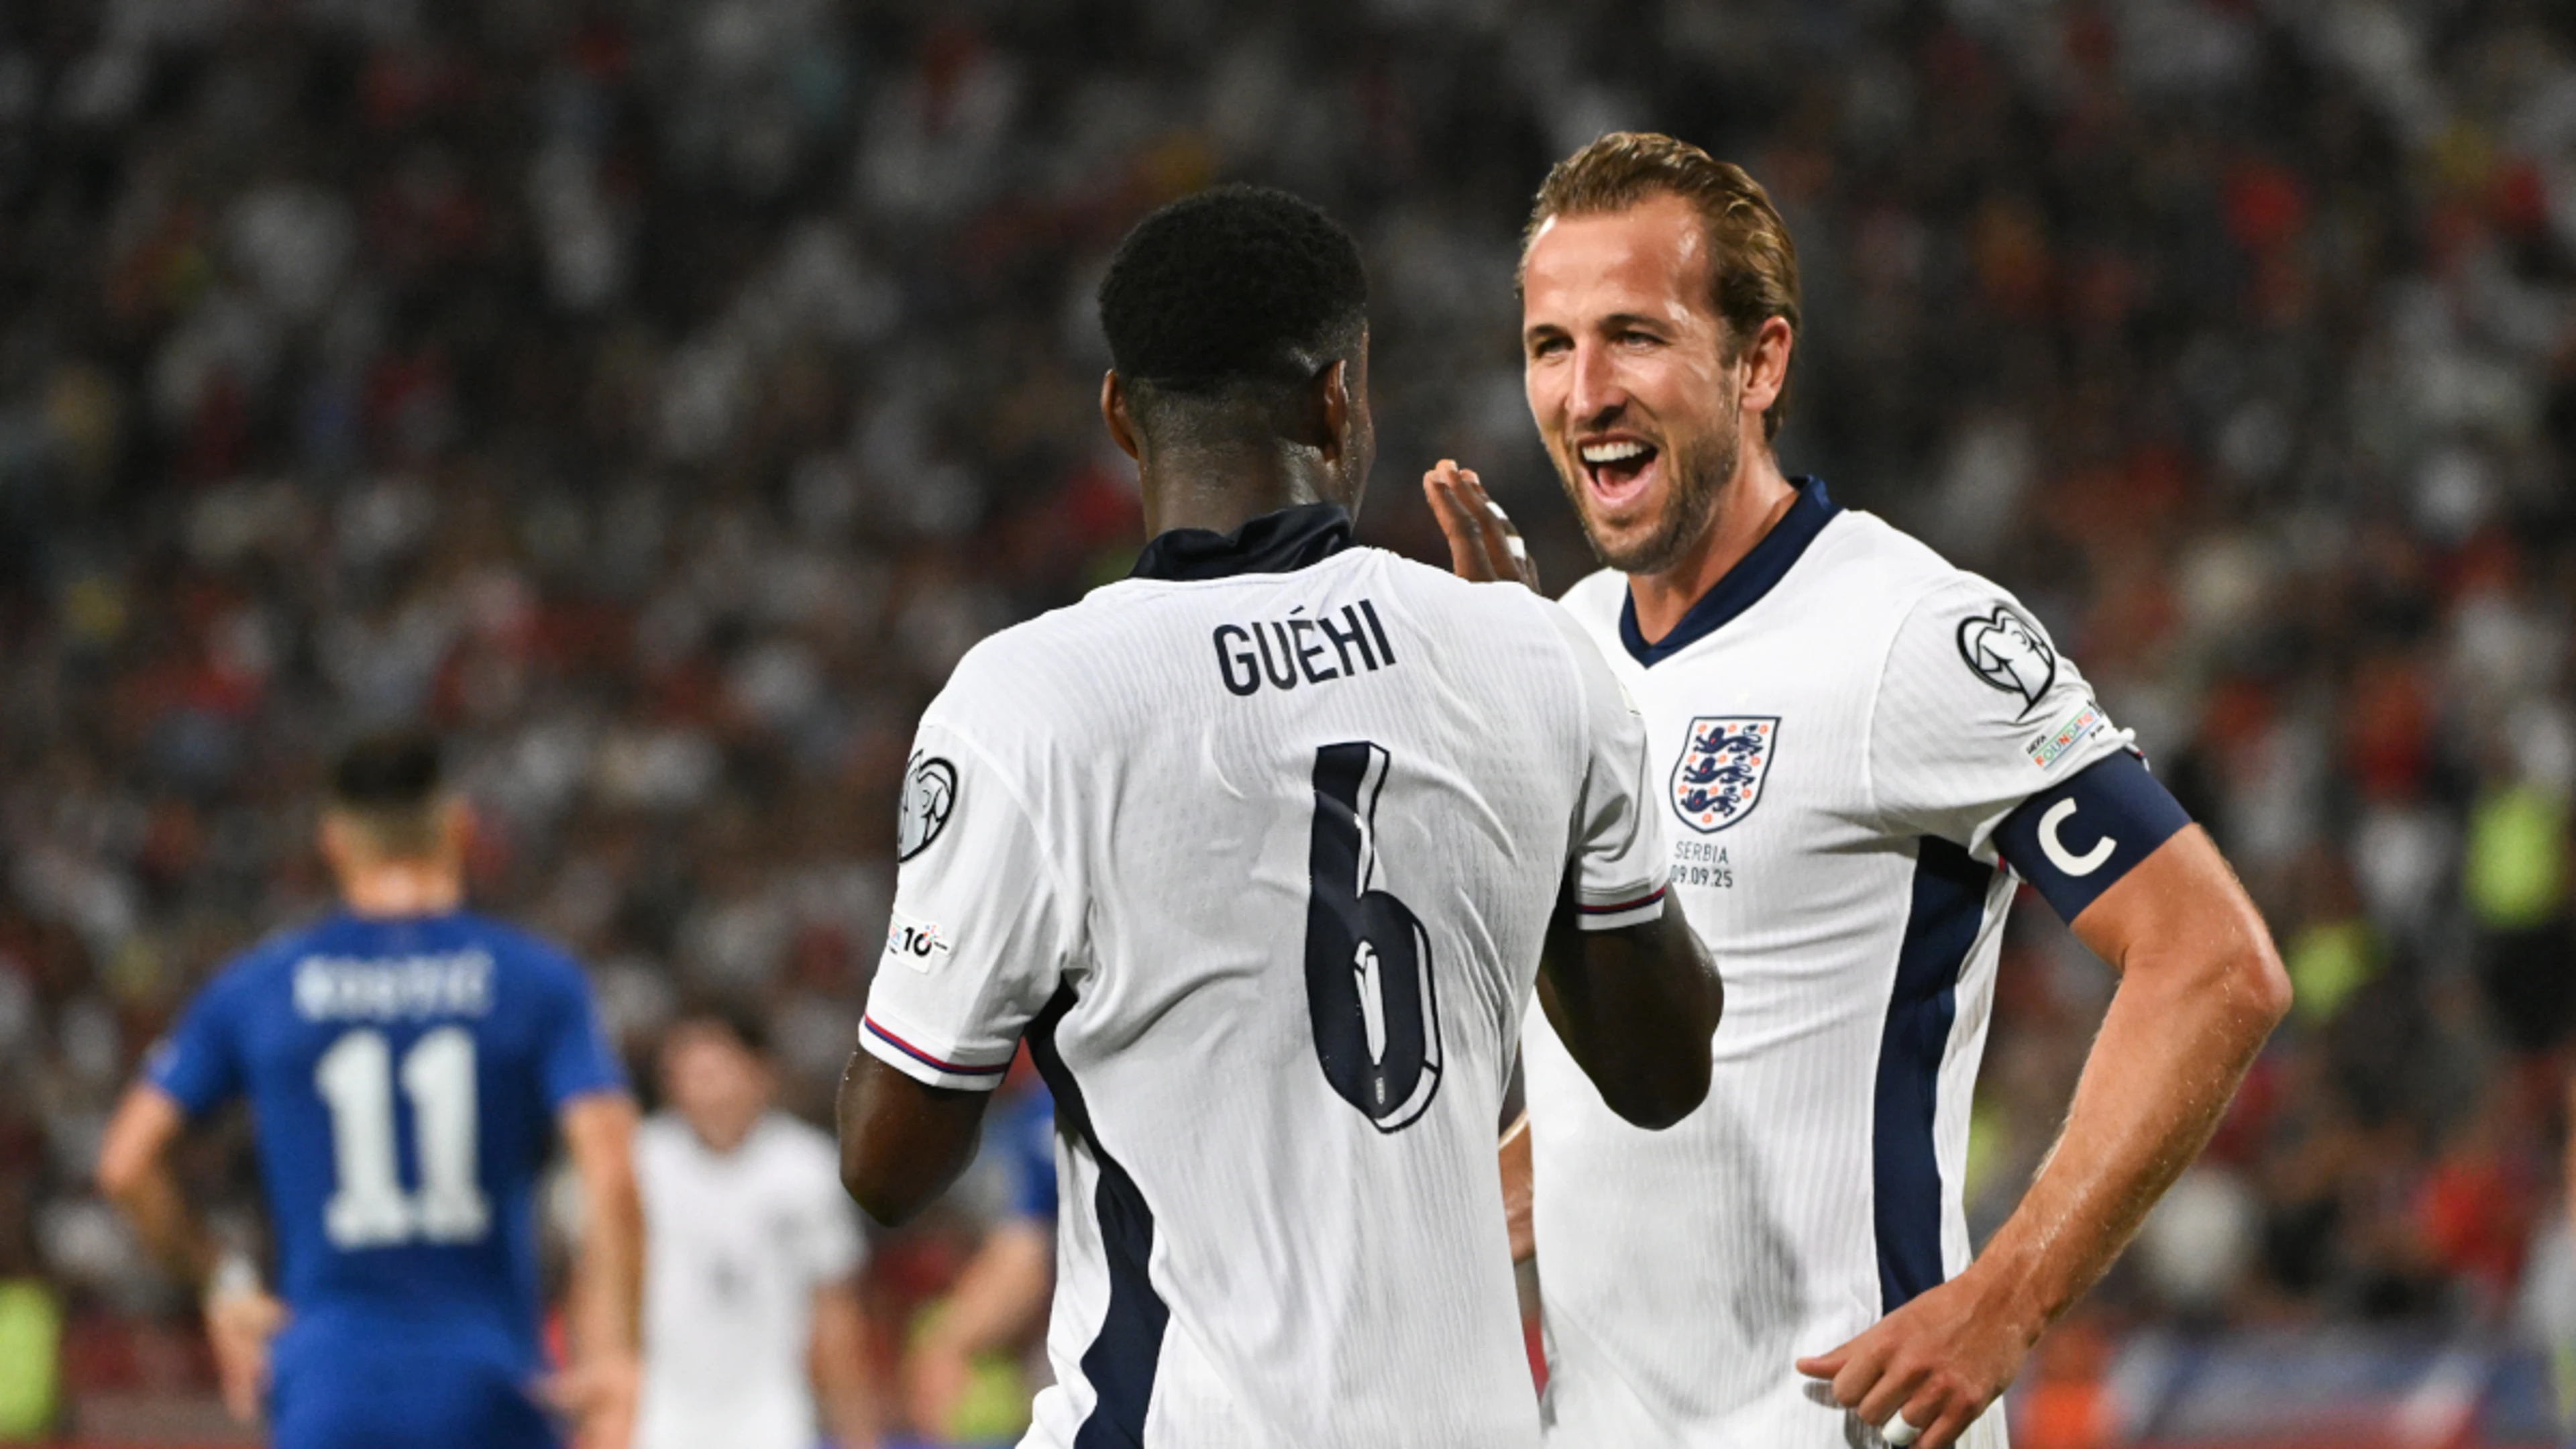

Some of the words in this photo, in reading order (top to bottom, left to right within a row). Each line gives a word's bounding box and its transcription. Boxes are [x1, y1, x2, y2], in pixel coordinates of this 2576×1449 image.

[1213, 598, 1396, 696] GUÉHI
[2026, 734, 2047, 755] UEFA
[1674, 840, 1729, 865] SERBIA
[2037, 796, 2117, 877] C
[1670, 864, 1733, 890] 09.09.25
[904, 926, 932, 958] 10
[1304, 741, 1443, 1134] 6
[315, 1028, 490, 1250] 11
